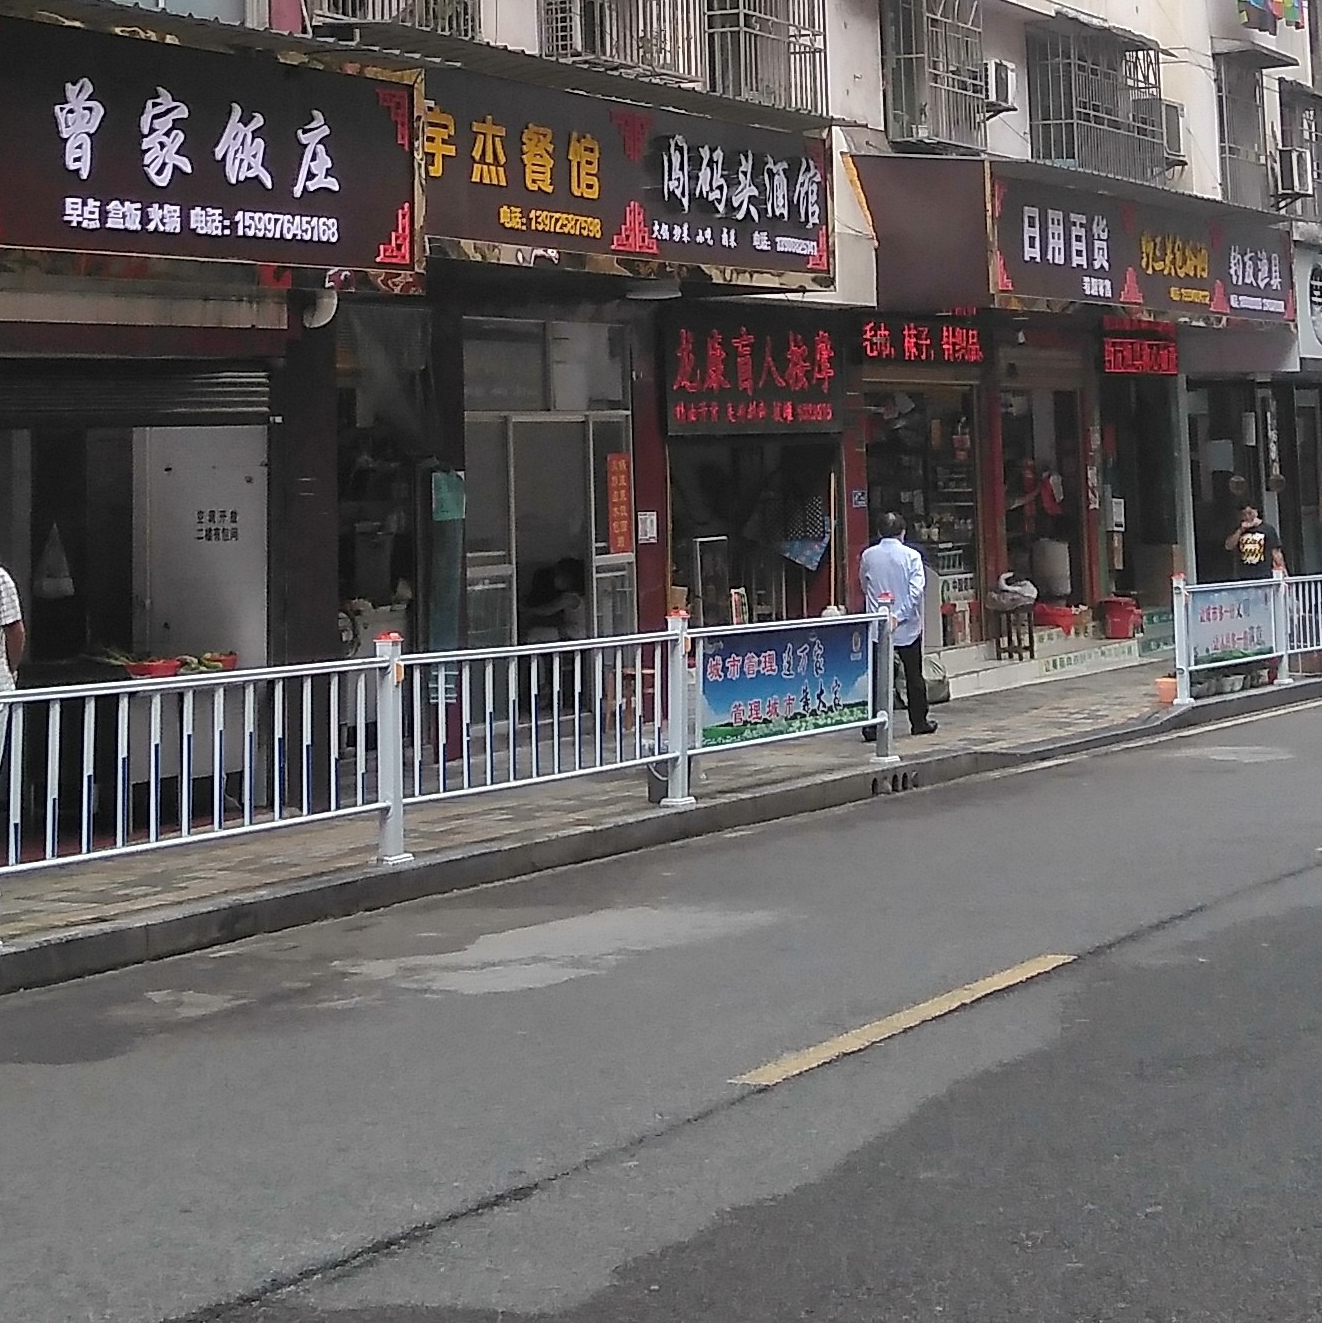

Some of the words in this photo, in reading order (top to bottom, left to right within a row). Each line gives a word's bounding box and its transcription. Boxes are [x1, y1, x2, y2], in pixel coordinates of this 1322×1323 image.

[54, 77, 340, 199] 曾家饭庄
[424, 108, 600, 200] 宇杰餐馆
[63, 197, 101, 229] 早点
[147, 203, 181, 233] 火锅
[1023, 206, 1110, 272] 日用百货
